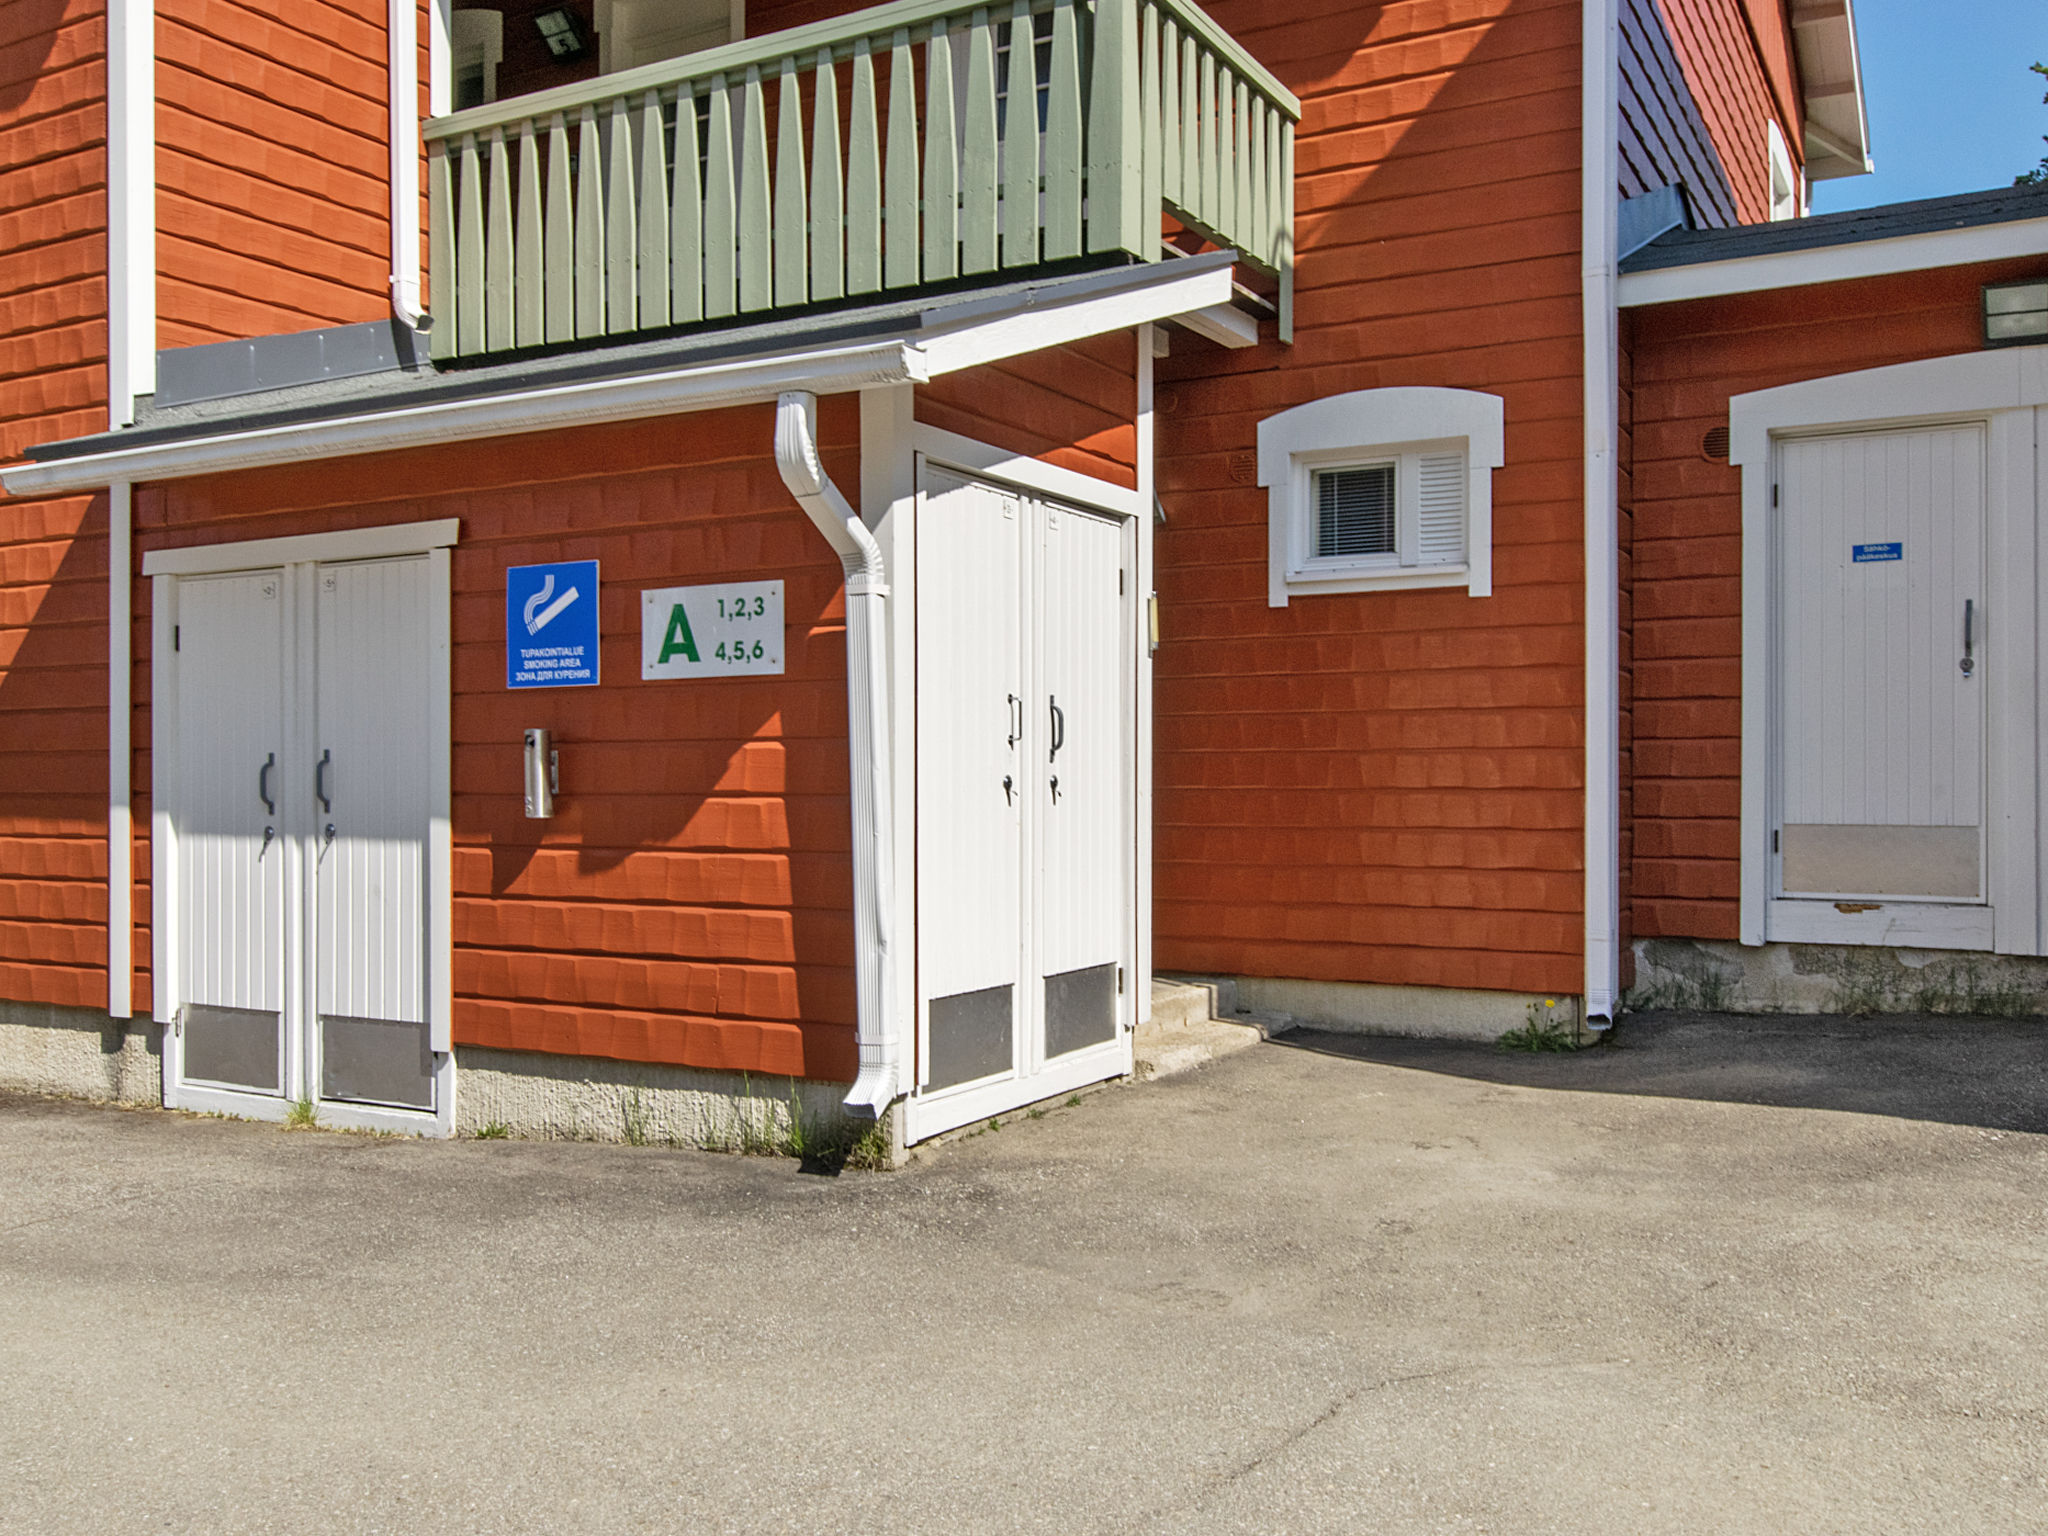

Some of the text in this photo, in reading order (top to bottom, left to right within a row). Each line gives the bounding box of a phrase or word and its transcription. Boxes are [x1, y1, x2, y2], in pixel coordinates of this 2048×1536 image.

[717, 596, 765, 622] 1,2,3
[657, 603, 701, 664] A
[520, 645, 585, 658] TUPAKOINTIALUE
[714, 640, 764, 664] 4,5,6
[523, 657, 582, 670] SMOKING AREA
[515, 668, 591, 682] ЗОНА ДЛЯ КУРЕНИЯ
